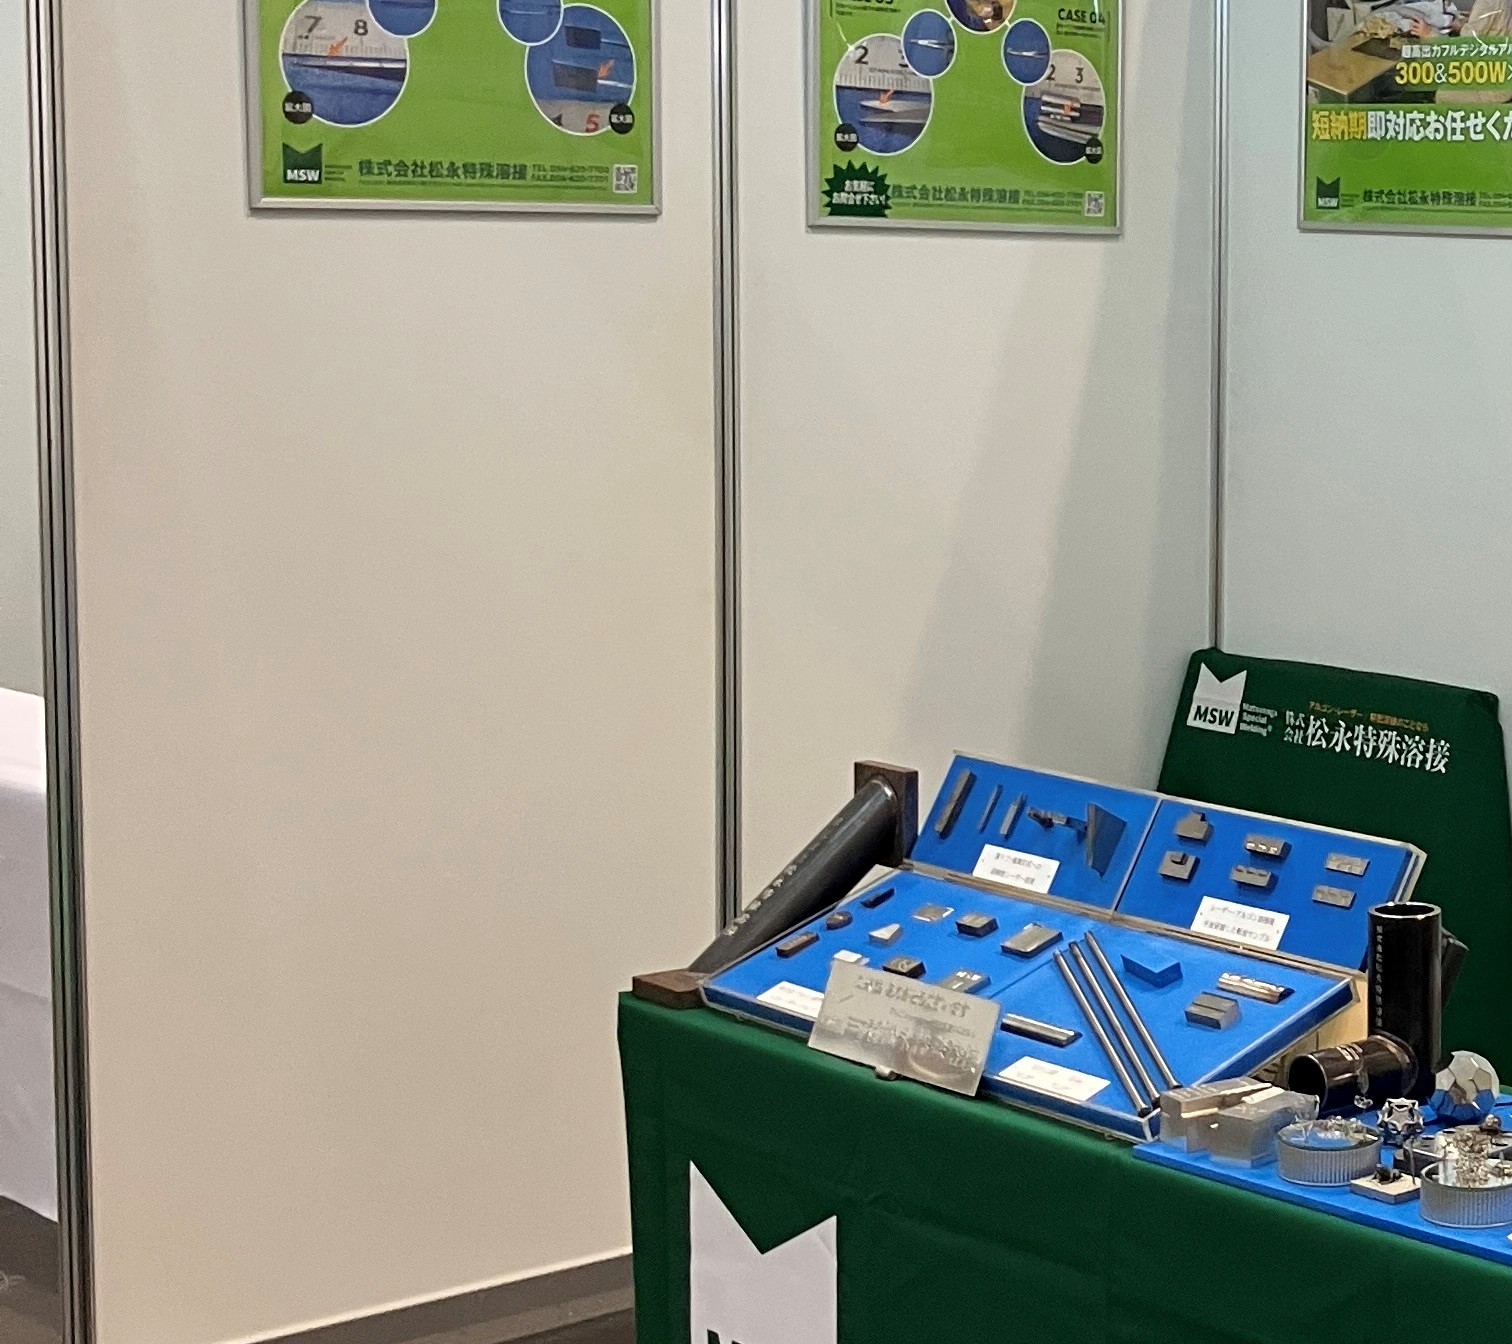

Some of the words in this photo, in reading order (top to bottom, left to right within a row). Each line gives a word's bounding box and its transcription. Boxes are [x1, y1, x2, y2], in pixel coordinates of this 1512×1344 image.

[1058, 8, 1087, 23] CASE
[286, 168, 320, 182] MSW
[1193, 704, 1235, 728] MSW
[1305, 714, 1451, 774] 松永特殊溶接
